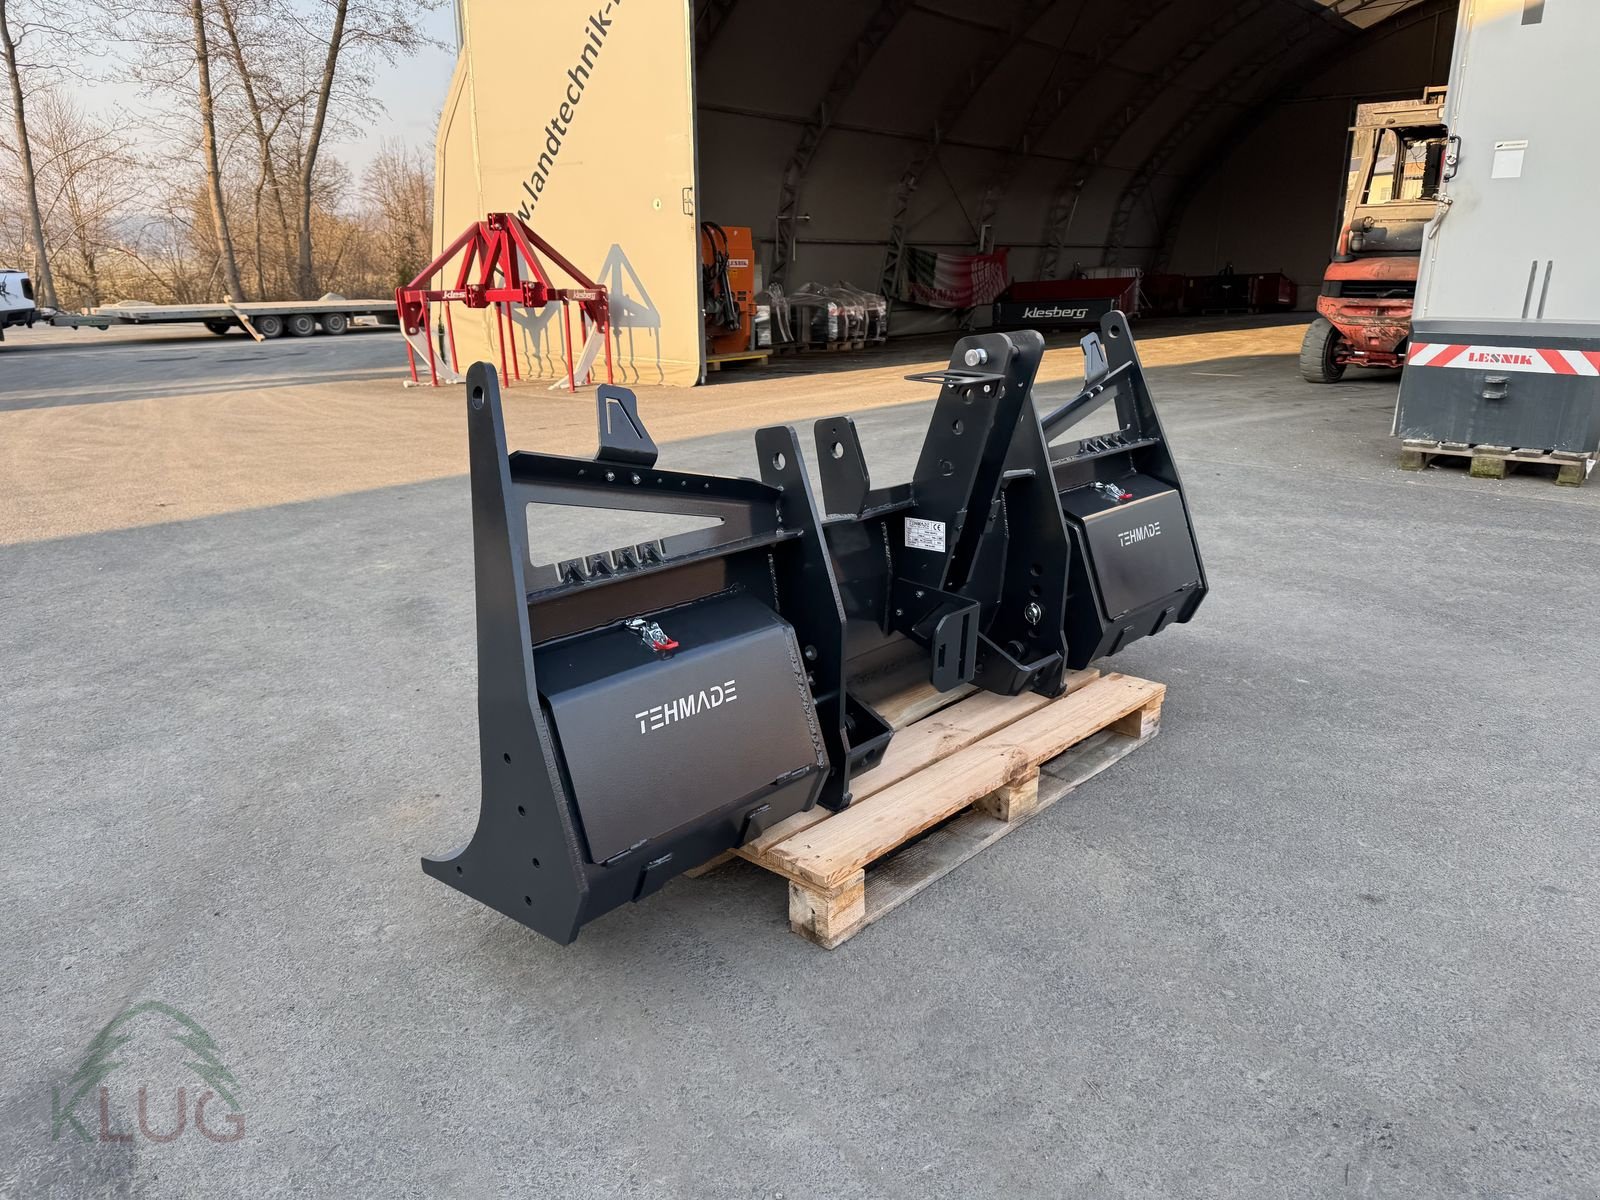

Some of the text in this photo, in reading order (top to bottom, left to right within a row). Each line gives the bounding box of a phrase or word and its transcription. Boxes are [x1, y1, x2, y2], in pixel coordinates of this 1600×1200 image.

[517, 0, 621, 224] w.landtechnik-
[442, 290, 467, 300] kles
[1022, 306, 1089, 319] klesberg
[1468, 352, 1532, 365] LESNIK
[1117, 521, 1161, 547] TEHMADE
[635, 680, 738, 735] TEHMADE
